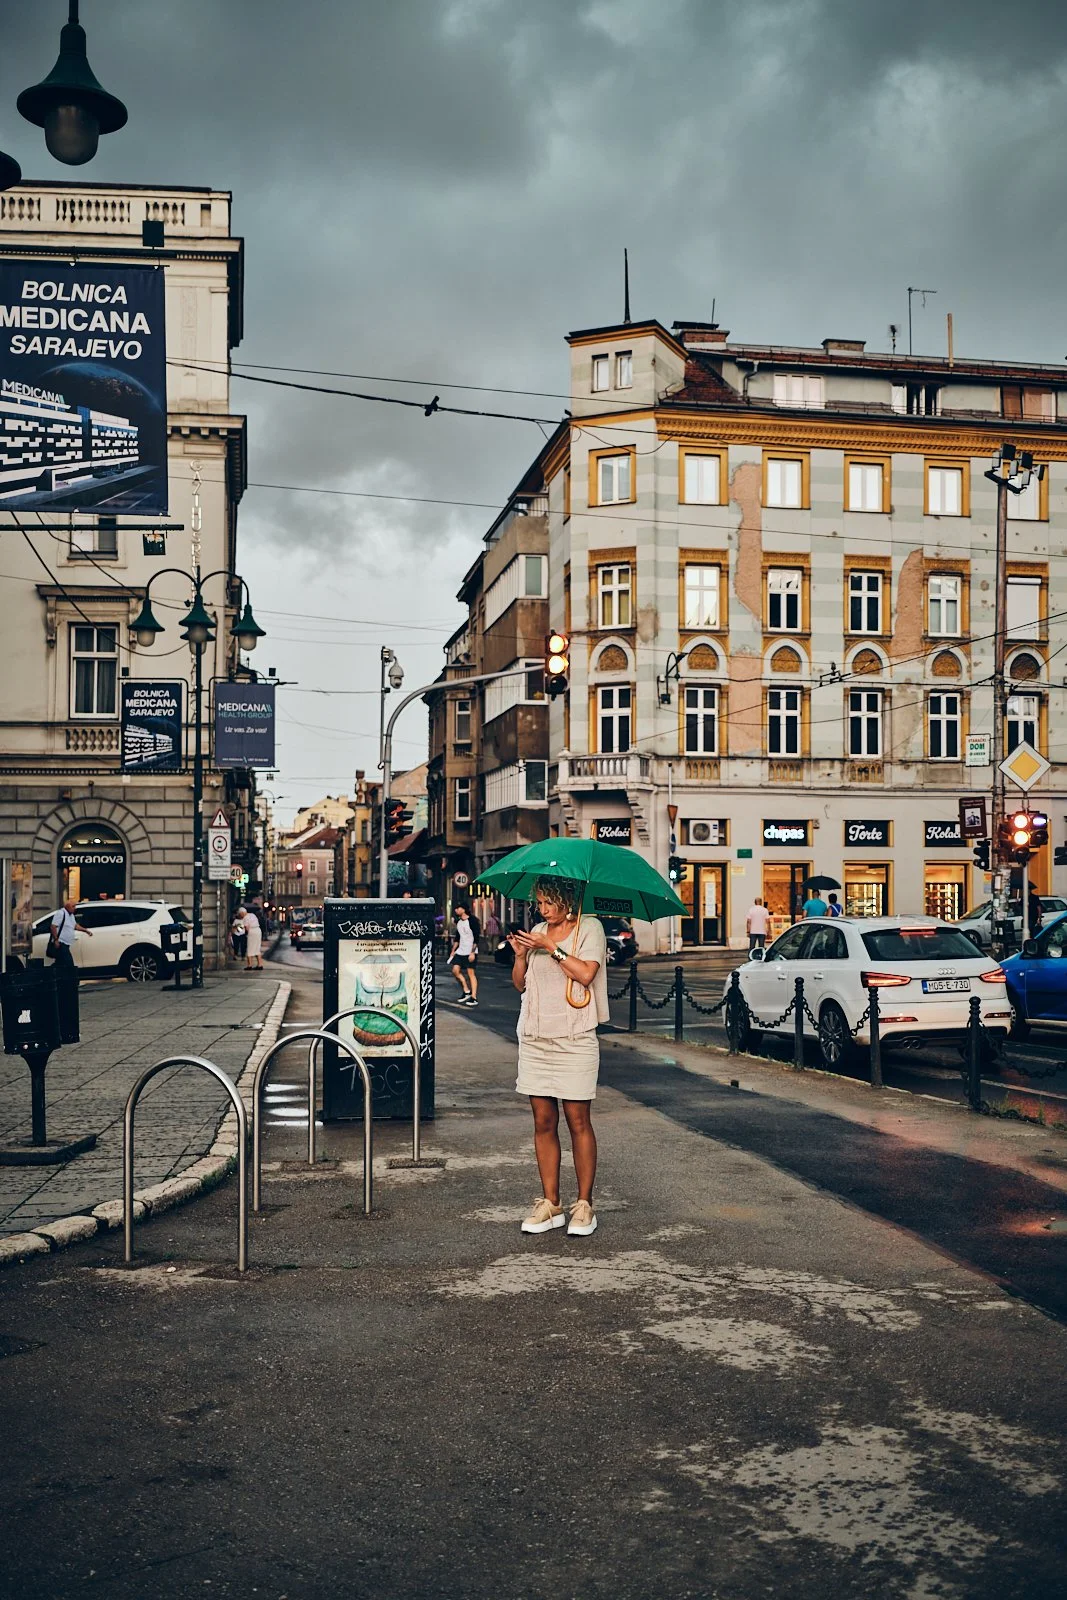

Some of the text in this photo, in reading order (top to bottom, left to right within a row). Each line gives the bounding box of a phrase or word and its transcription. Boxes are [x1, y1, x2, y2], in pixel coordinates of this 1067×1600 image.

[21, 281, 128, 305] BOLNICA
[0, 305, 151, 335] MEDICANA
[9, 335, 142, 360] SARAJEVO
[2, 378, 61, 404] MEDICANA
[133, 690, 170, 698] BOLNICA
[125, 699, 178, 708] MEDICANA
[218, 703, 267, 712] MEDICANA
[129, 708, 175, 717] SARAJEVO
[848, 824, 883, 842] Torte
[230, 868, 241, 878] 40
[456, 875, 466, 884] 40
